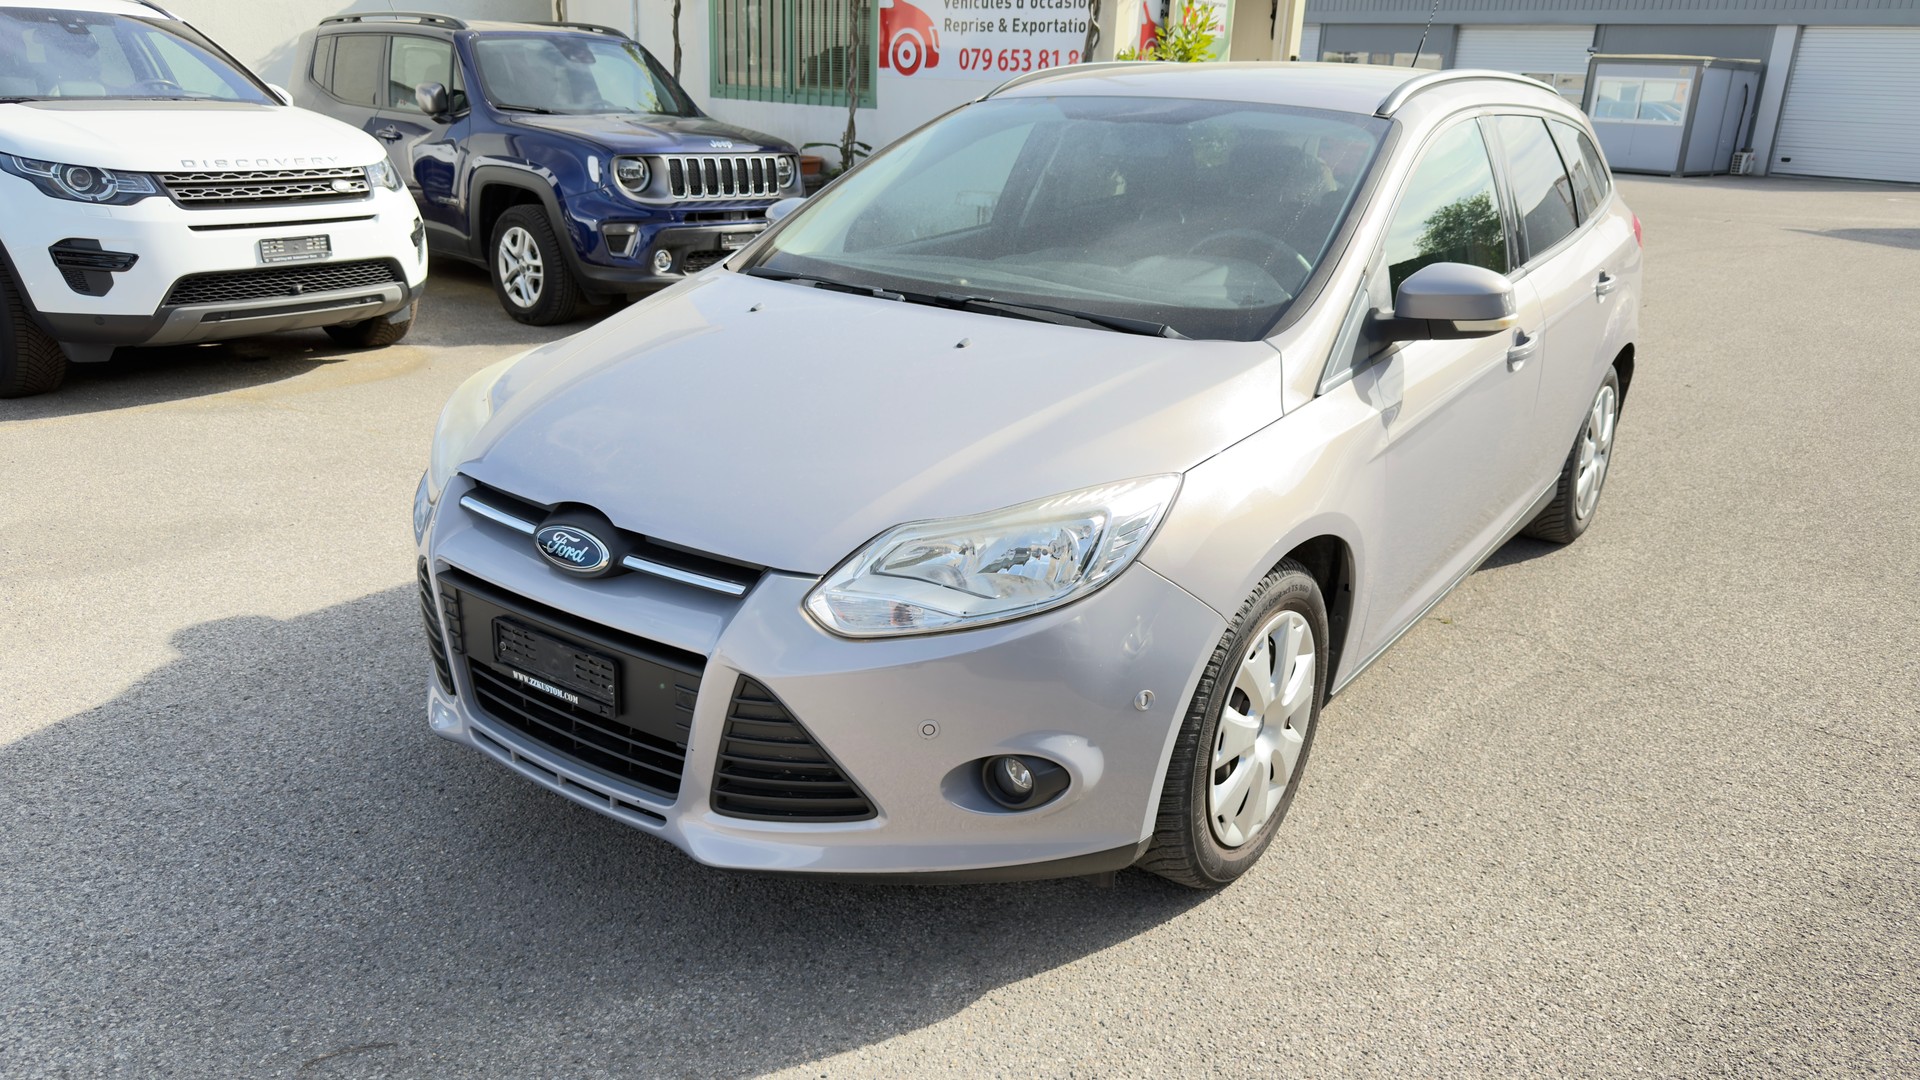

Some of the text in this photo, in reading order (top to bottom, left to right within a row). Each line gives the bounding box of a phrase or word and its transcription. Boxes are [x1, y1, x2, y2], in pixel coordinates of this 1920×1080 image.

[944, 18, 1087, 36] Reprise & Exportatio
[958, 48, 993, 71] 079
[997, 49, 1032, 72] 653
[1037, 49, 1060, 70] 81
[710, 139, 733, 149] Jeep
[180, 156, 338, 168] DISCOVERY
[547, 531, 589, 563] Ford
[512, 670, 579, 705] WWW.ZZKUSTOM.COM
